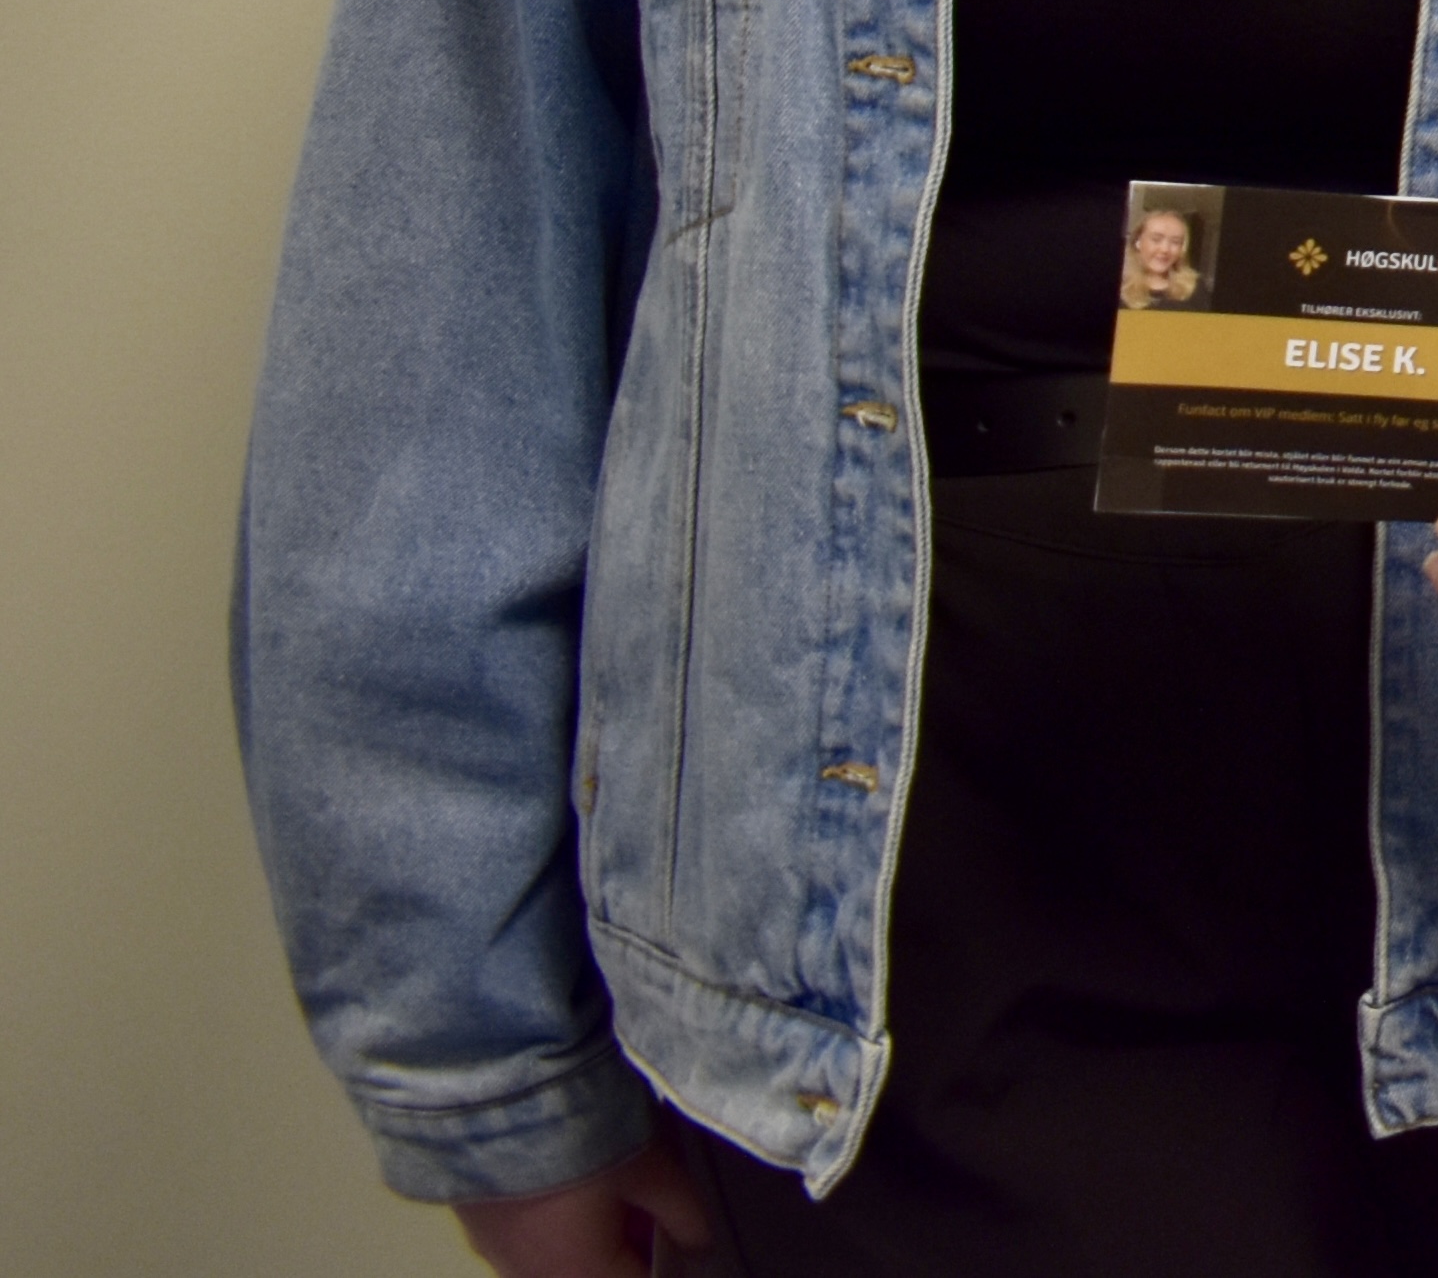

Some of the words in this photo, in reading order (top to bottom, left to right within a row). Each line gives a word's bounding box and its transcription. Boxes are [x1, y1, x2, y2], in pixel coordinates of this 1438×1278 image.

[1300, 303, 1354, 317] TILHØRER
[1354, 307, 1421, 321] EKSKLUSIVT:
[1284, 338, 1384, 372] ELISE
[1392, 345, 1425, 375] K.
[1177, 402, 1227, 418] Funfact
[1227, 407, 1253, 419] om
[1251, 406, 1276, 419] VIP
[1337, 410, 1364, 424] Satt
